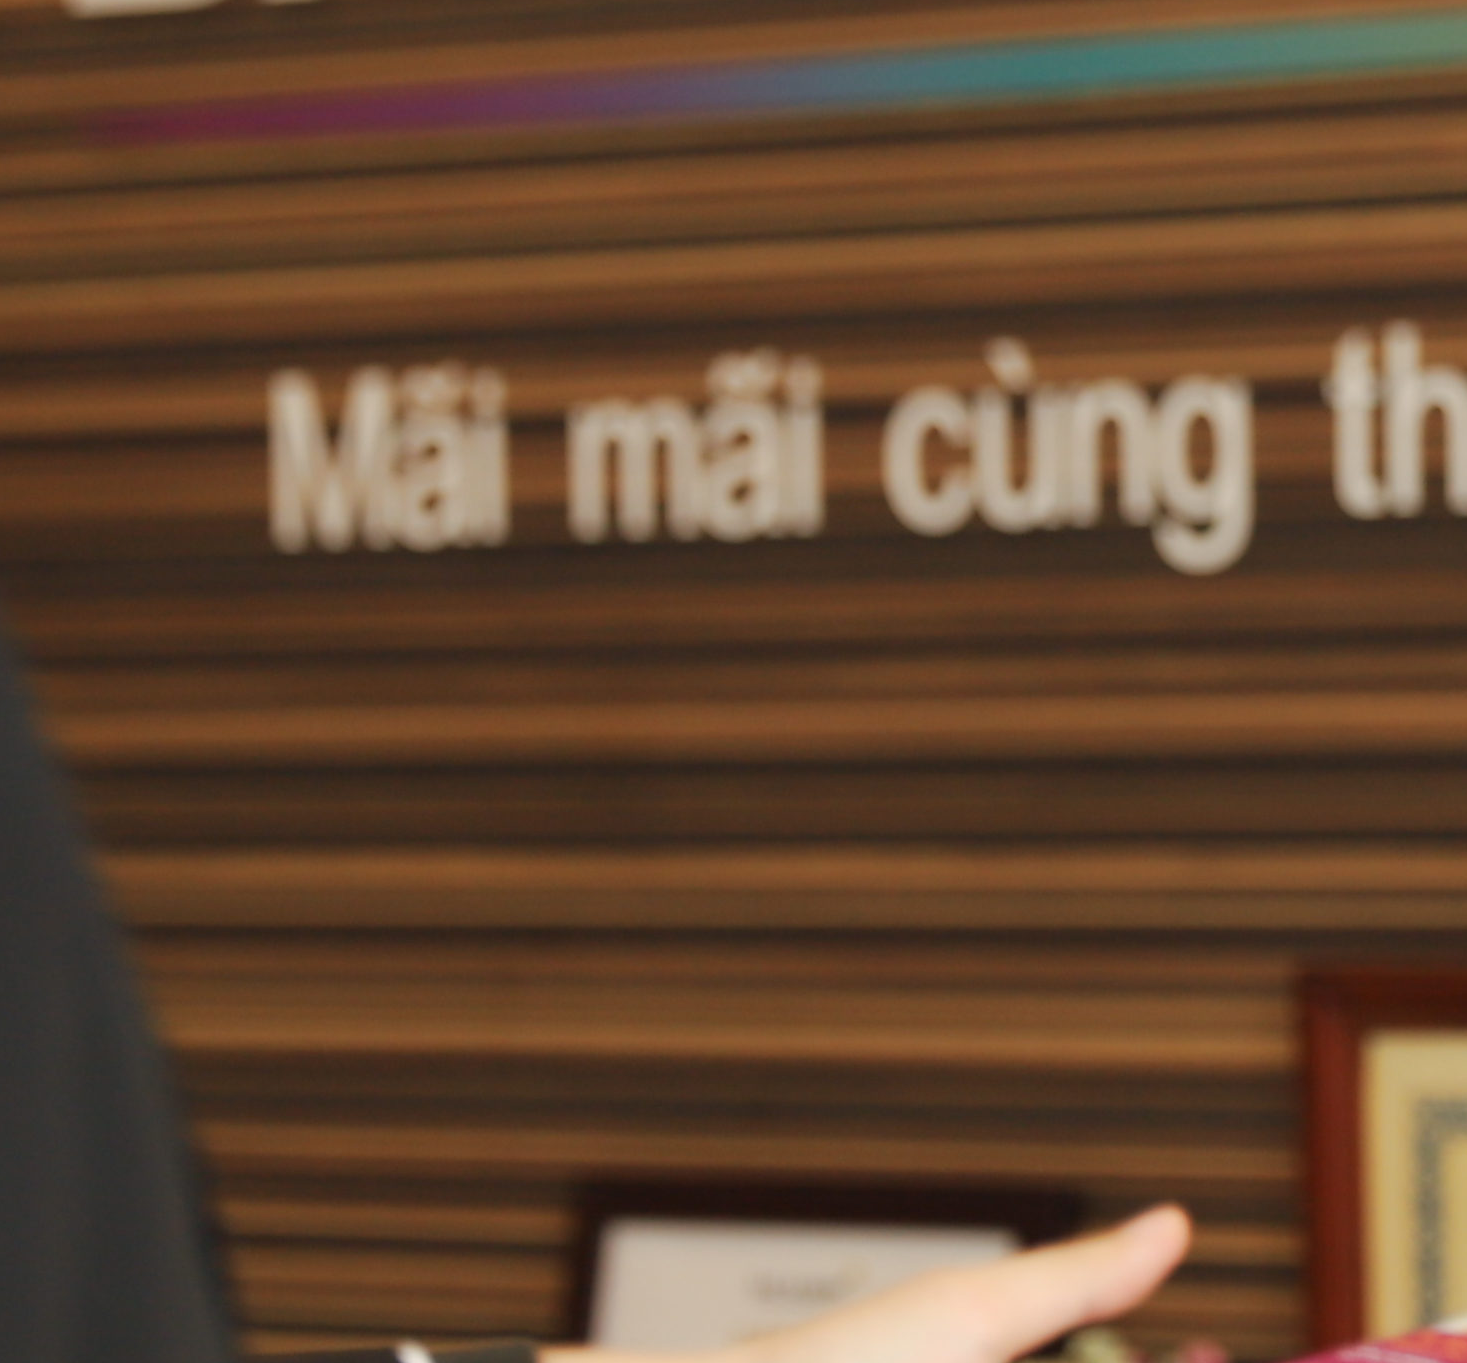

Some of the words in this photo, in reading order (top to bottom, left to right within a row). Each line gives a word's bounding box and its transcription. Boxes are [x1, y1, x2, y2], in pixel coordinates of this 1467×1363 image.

[265, 354, 511, 553] Mãi
[567, 348, 827, 544] mãi
[880, 338, 1256, 576] cùng
